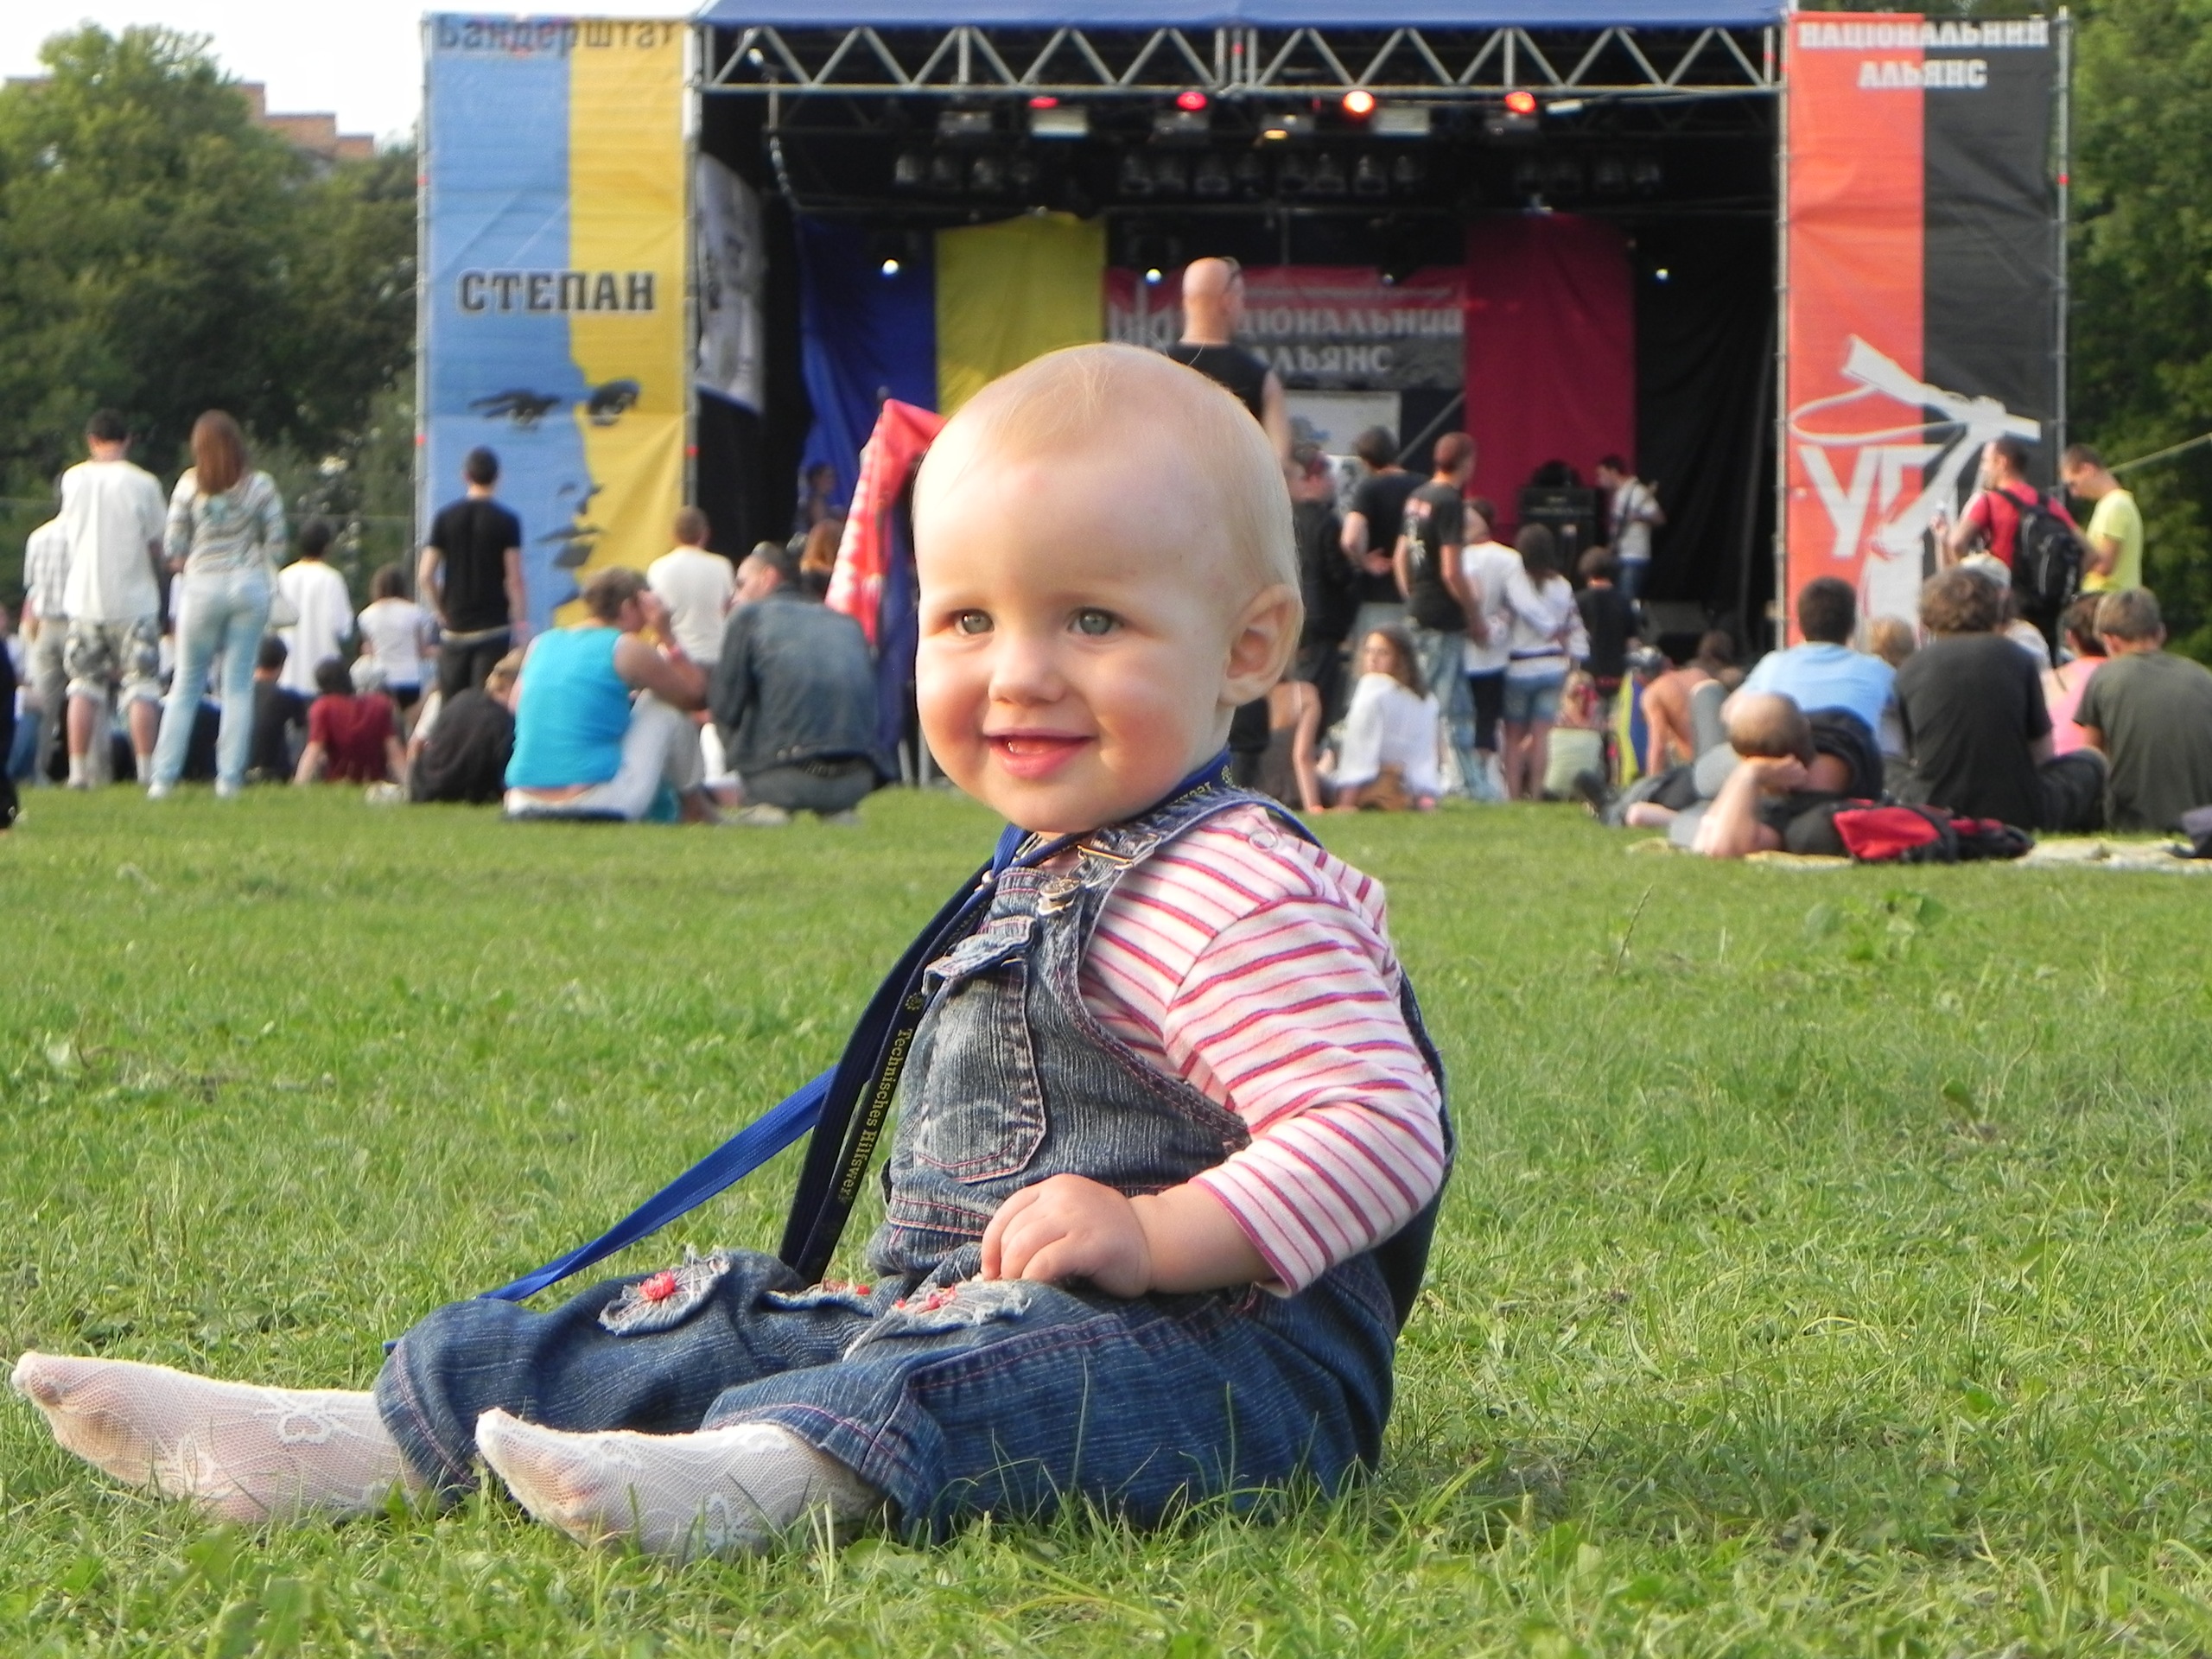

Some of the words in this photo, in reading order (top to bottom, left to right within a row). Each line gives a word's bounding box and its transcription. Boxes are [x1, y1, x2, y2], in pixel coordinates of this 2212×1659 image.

[1859, 60, 1987, 89] АЛЬЯНС
[460, 270, 655, 311] СТЕПАН
[866, 1027, 913, 1127] Technisches
